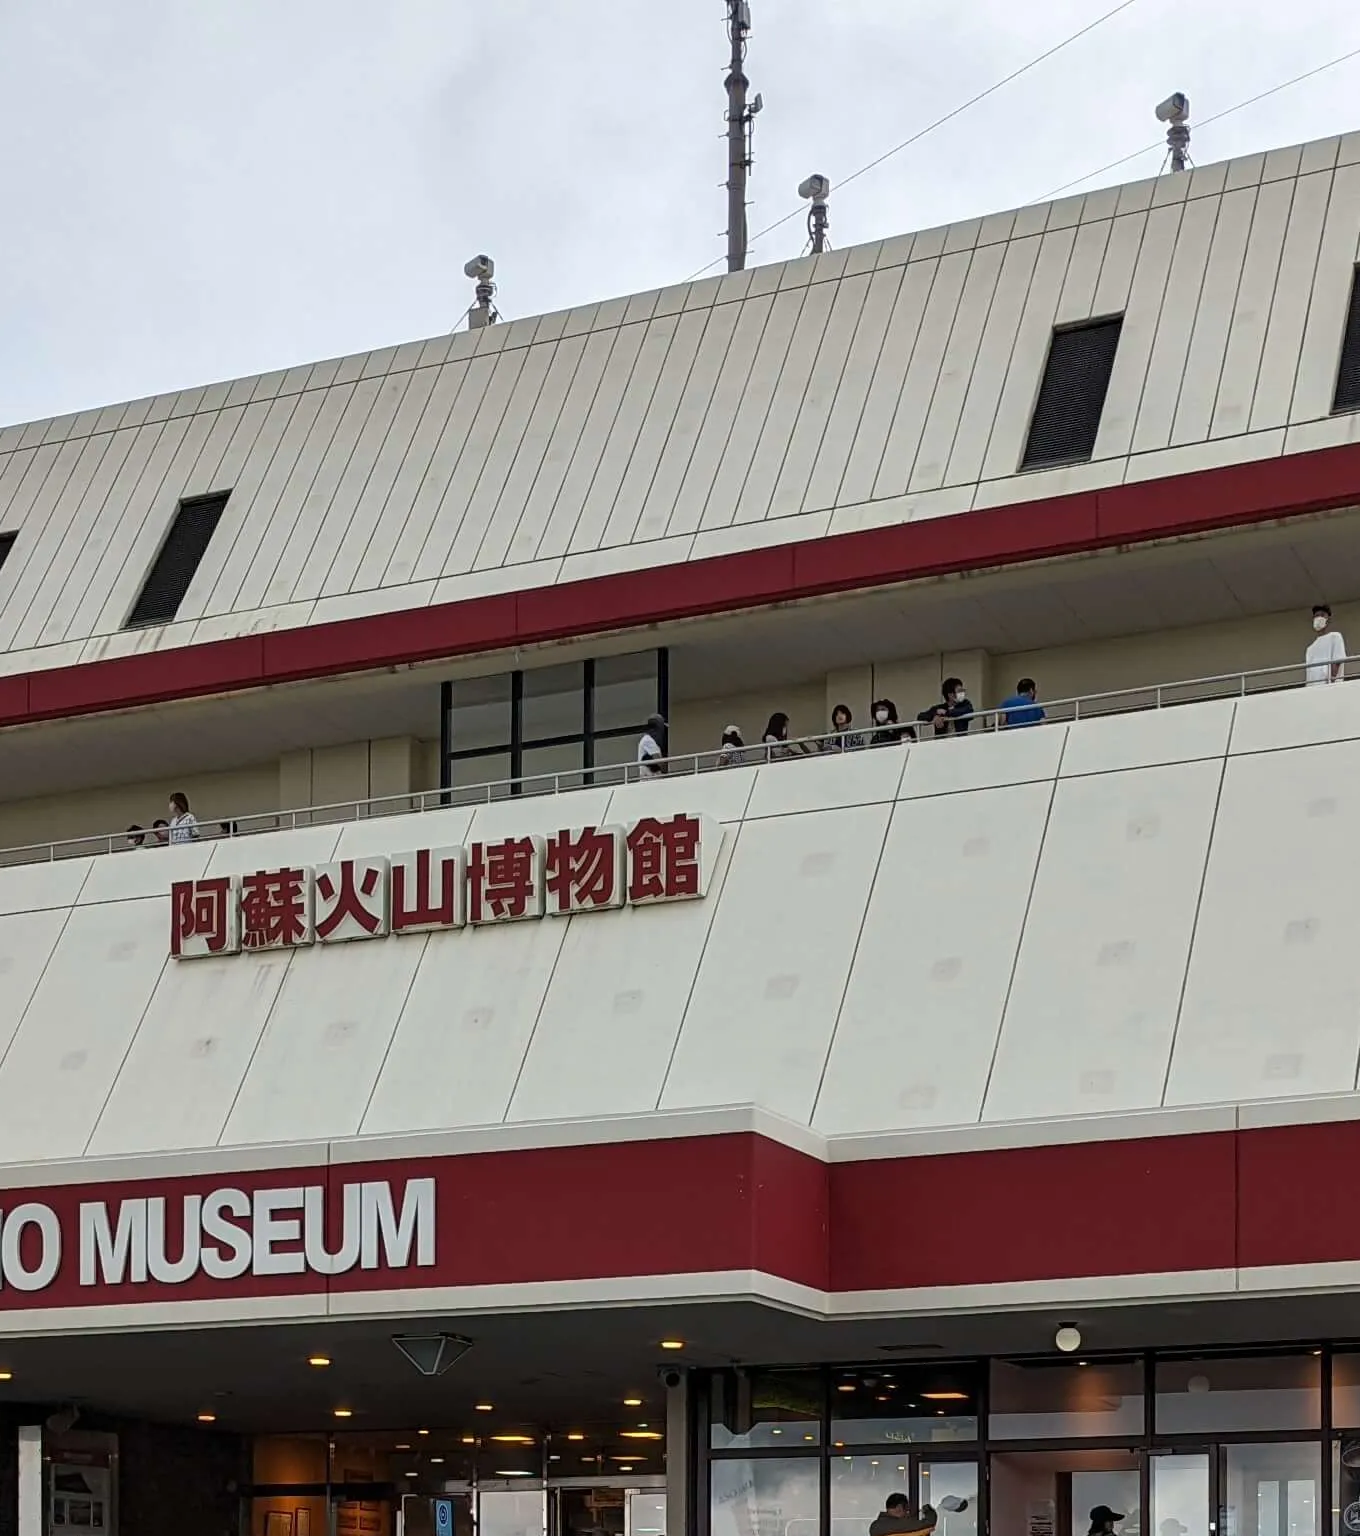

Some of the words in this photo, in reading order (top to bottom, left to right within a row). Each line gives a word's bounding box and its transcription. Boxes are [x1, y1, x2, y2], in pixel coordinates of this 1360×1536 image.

[170, 813, 702, 956] 阿蘇火山博物館
[79, 1177, 438, 1287] MUSEUM
